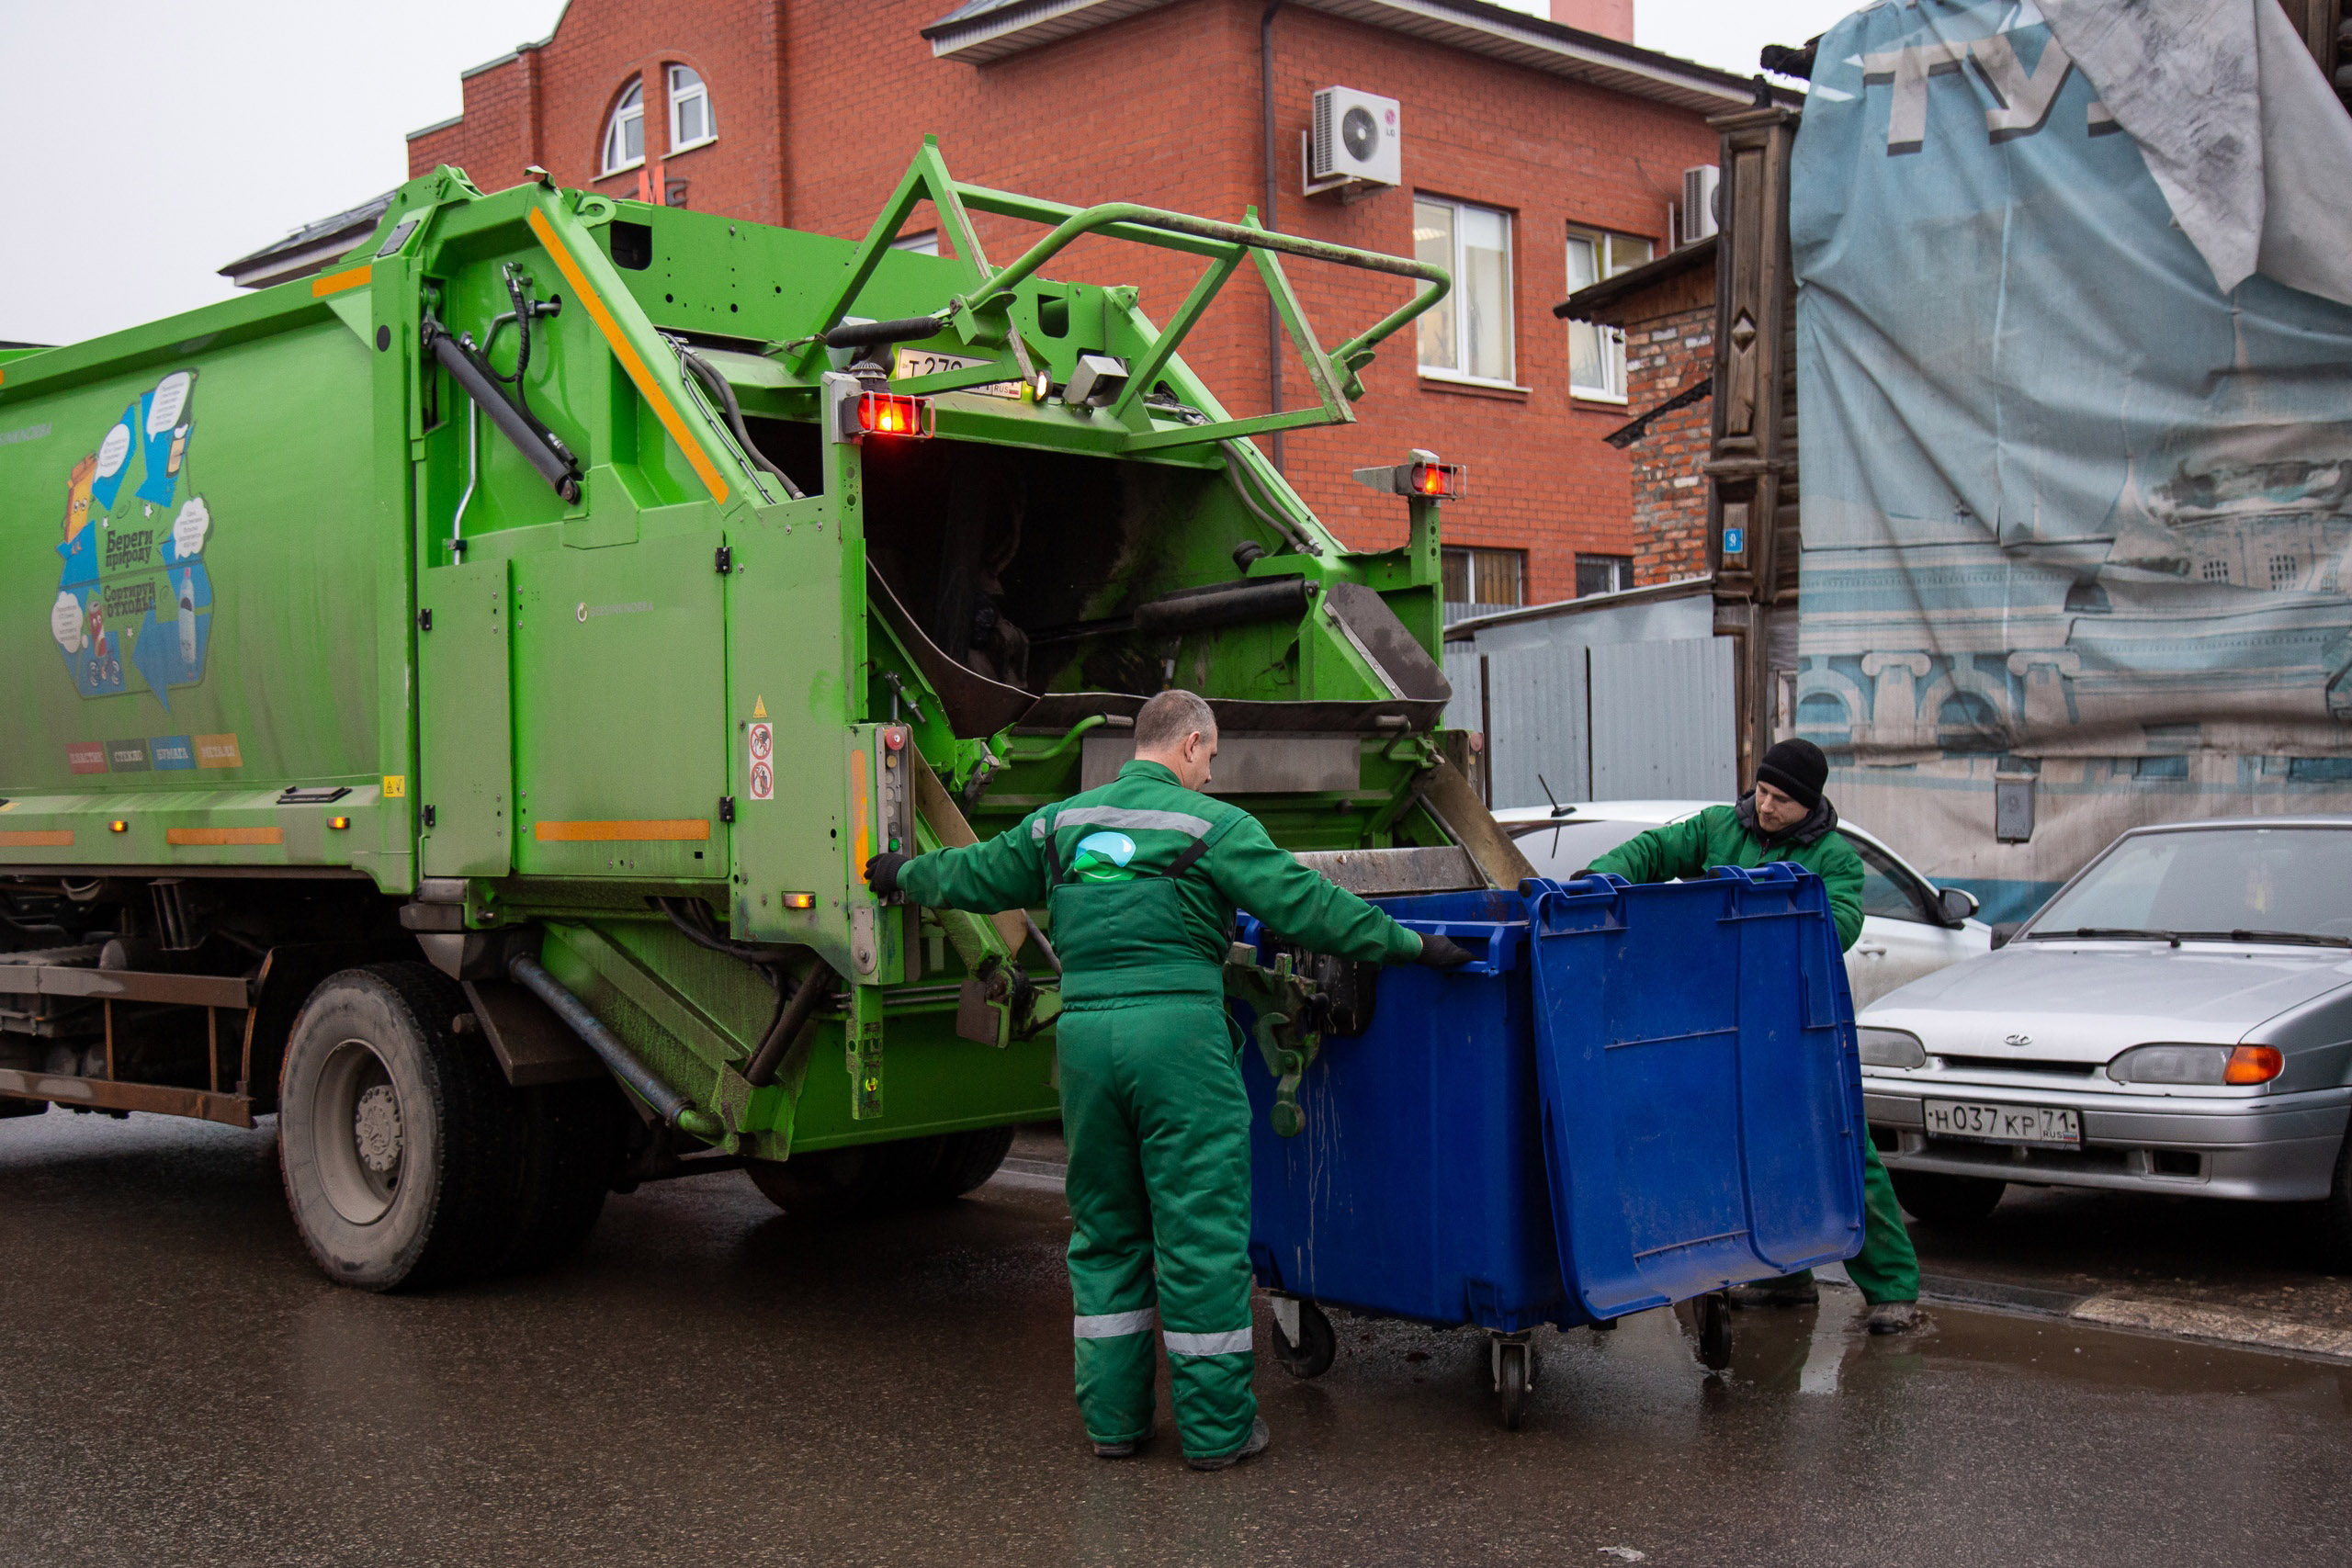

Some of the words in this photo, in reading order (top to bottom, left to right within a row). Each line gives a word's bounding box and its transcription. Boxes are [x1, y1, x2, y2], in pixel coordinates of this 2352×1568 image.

[1385, 128, 1396, 138] LG
[994, 385, 1009, 393] RUS
[106, 529, 153, 554] Береги
[1728, 532, 1736, 547] 9
[106, 546, 153, 570] природу
[104, 577, 155, 603] Сортируй
[114, 750, 144, 762] СТЕКЛО
[155, 747, 189, 761] БУМАГА
[2041, 1110, 2069, 1133] 71
[2042, 1130, 2064, 1139] RUS
